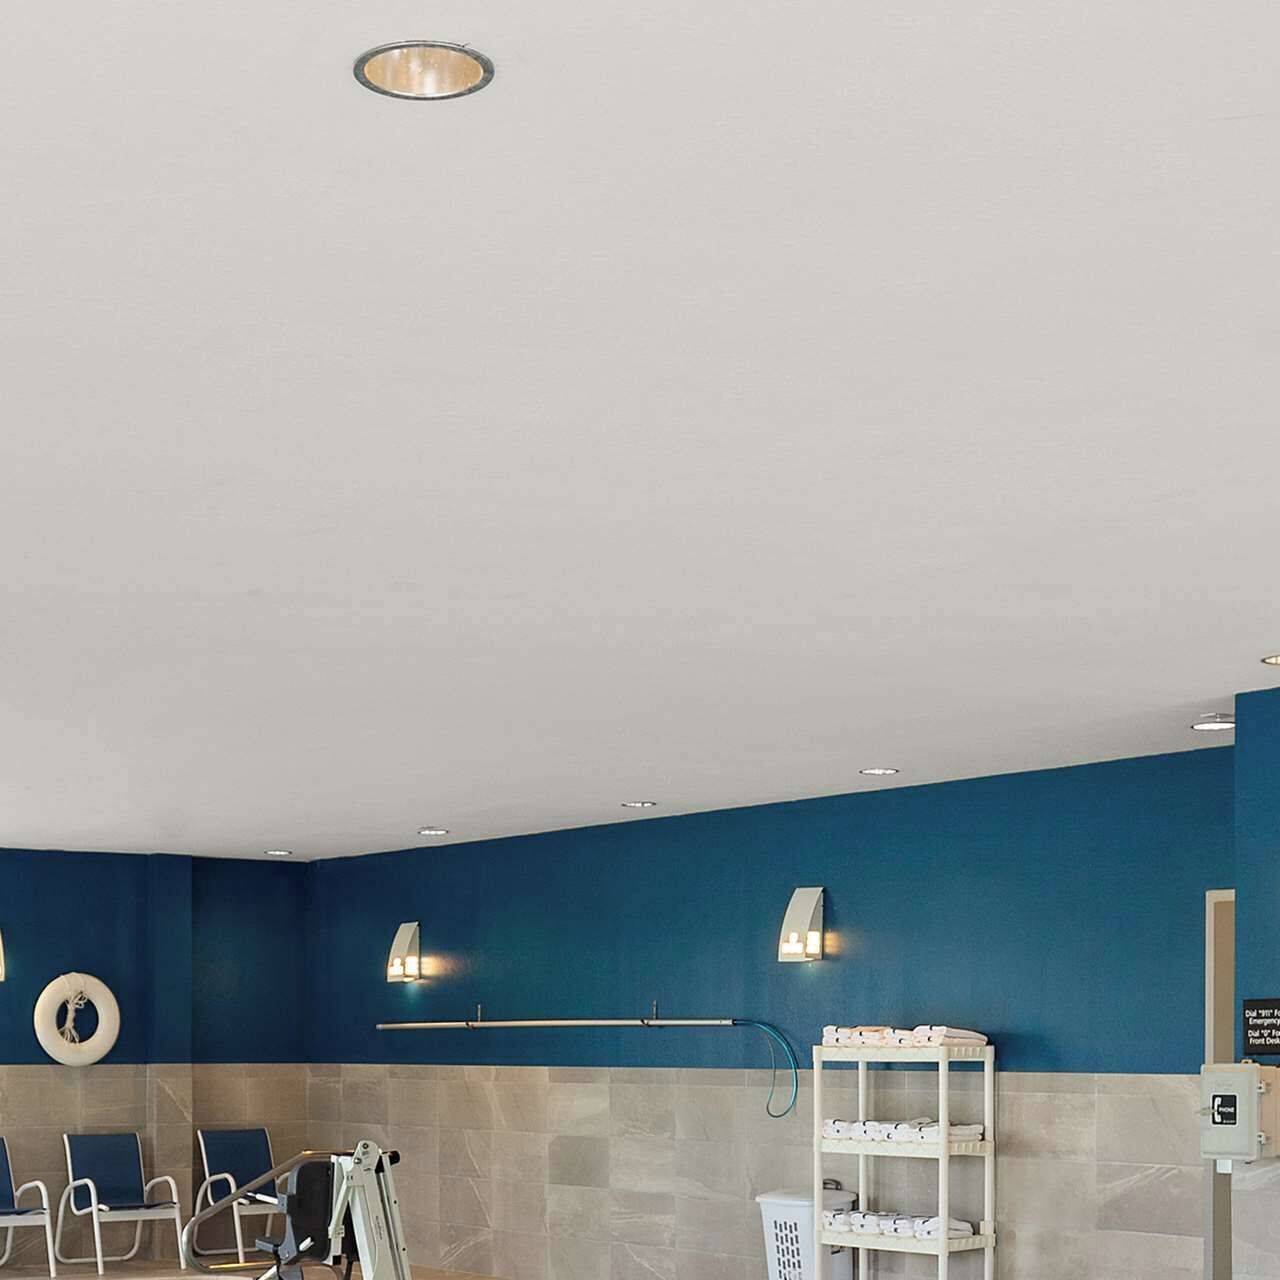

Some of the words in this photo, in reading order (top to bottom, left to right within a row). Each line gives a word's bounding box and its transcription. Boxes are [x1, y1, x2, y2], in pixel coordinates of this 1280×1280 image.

[1245, 1009, 1257, 1018] Dial
[1248, 1029, 1260, 1038] Dial
[1249, 1037, 1265, 1045] Front
[1266, 1037, 1280, 1045] Desk
